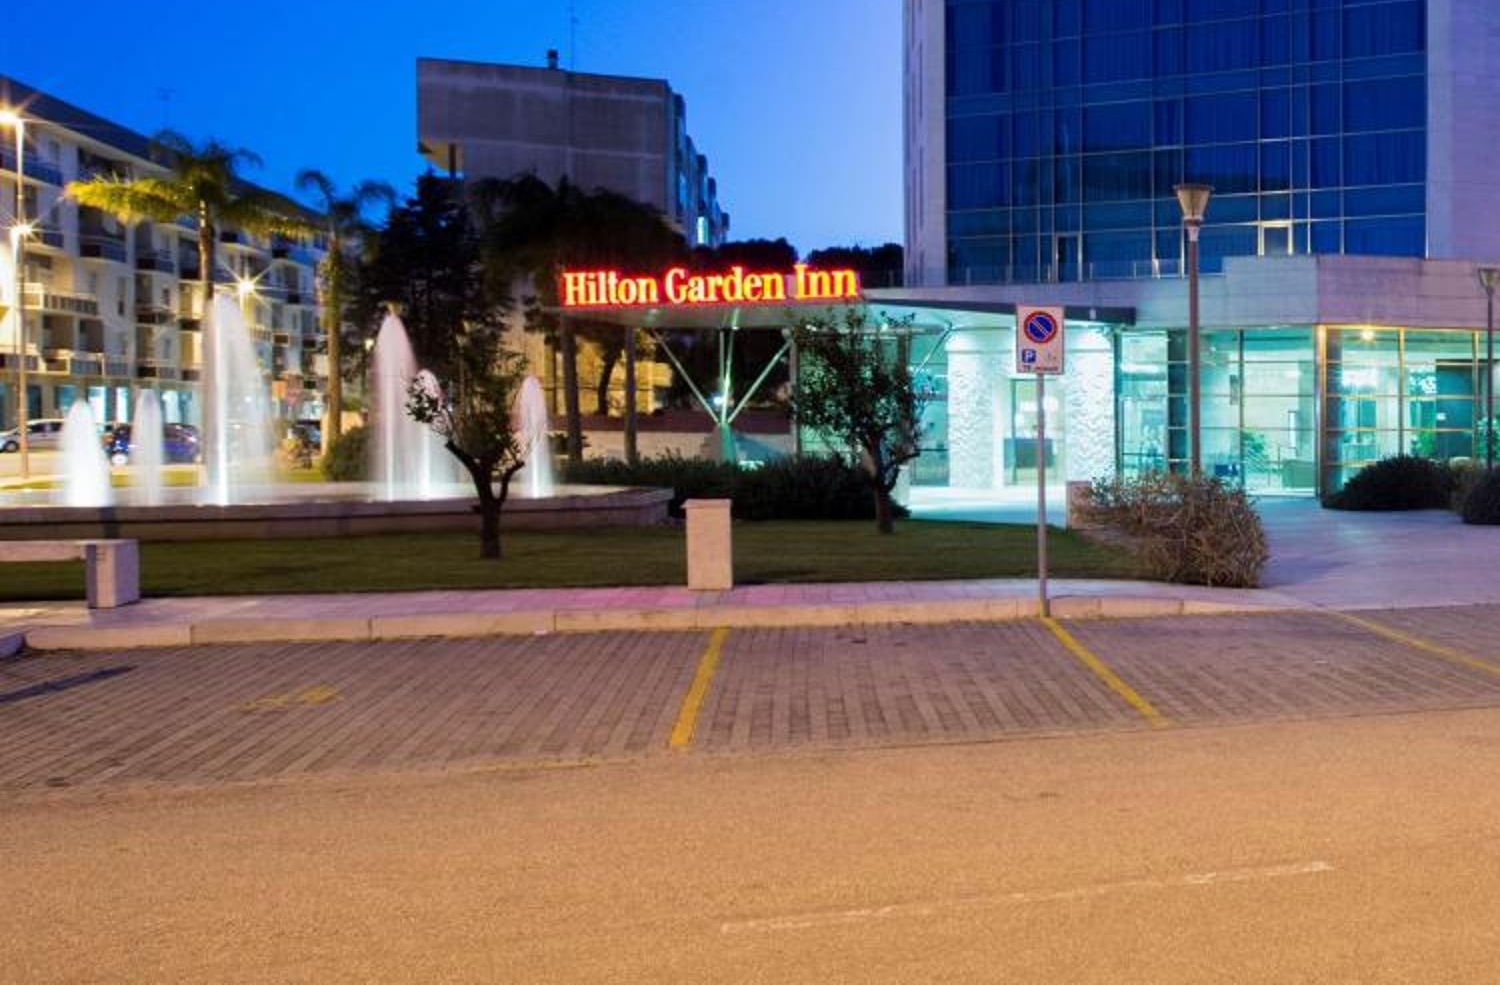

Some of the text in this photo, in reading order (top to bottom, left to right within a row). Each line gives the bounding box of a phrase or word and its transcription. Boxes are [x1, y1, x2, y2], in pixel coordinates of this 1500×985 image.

[563, 264, 858, 305] Hilton Garden Inn
